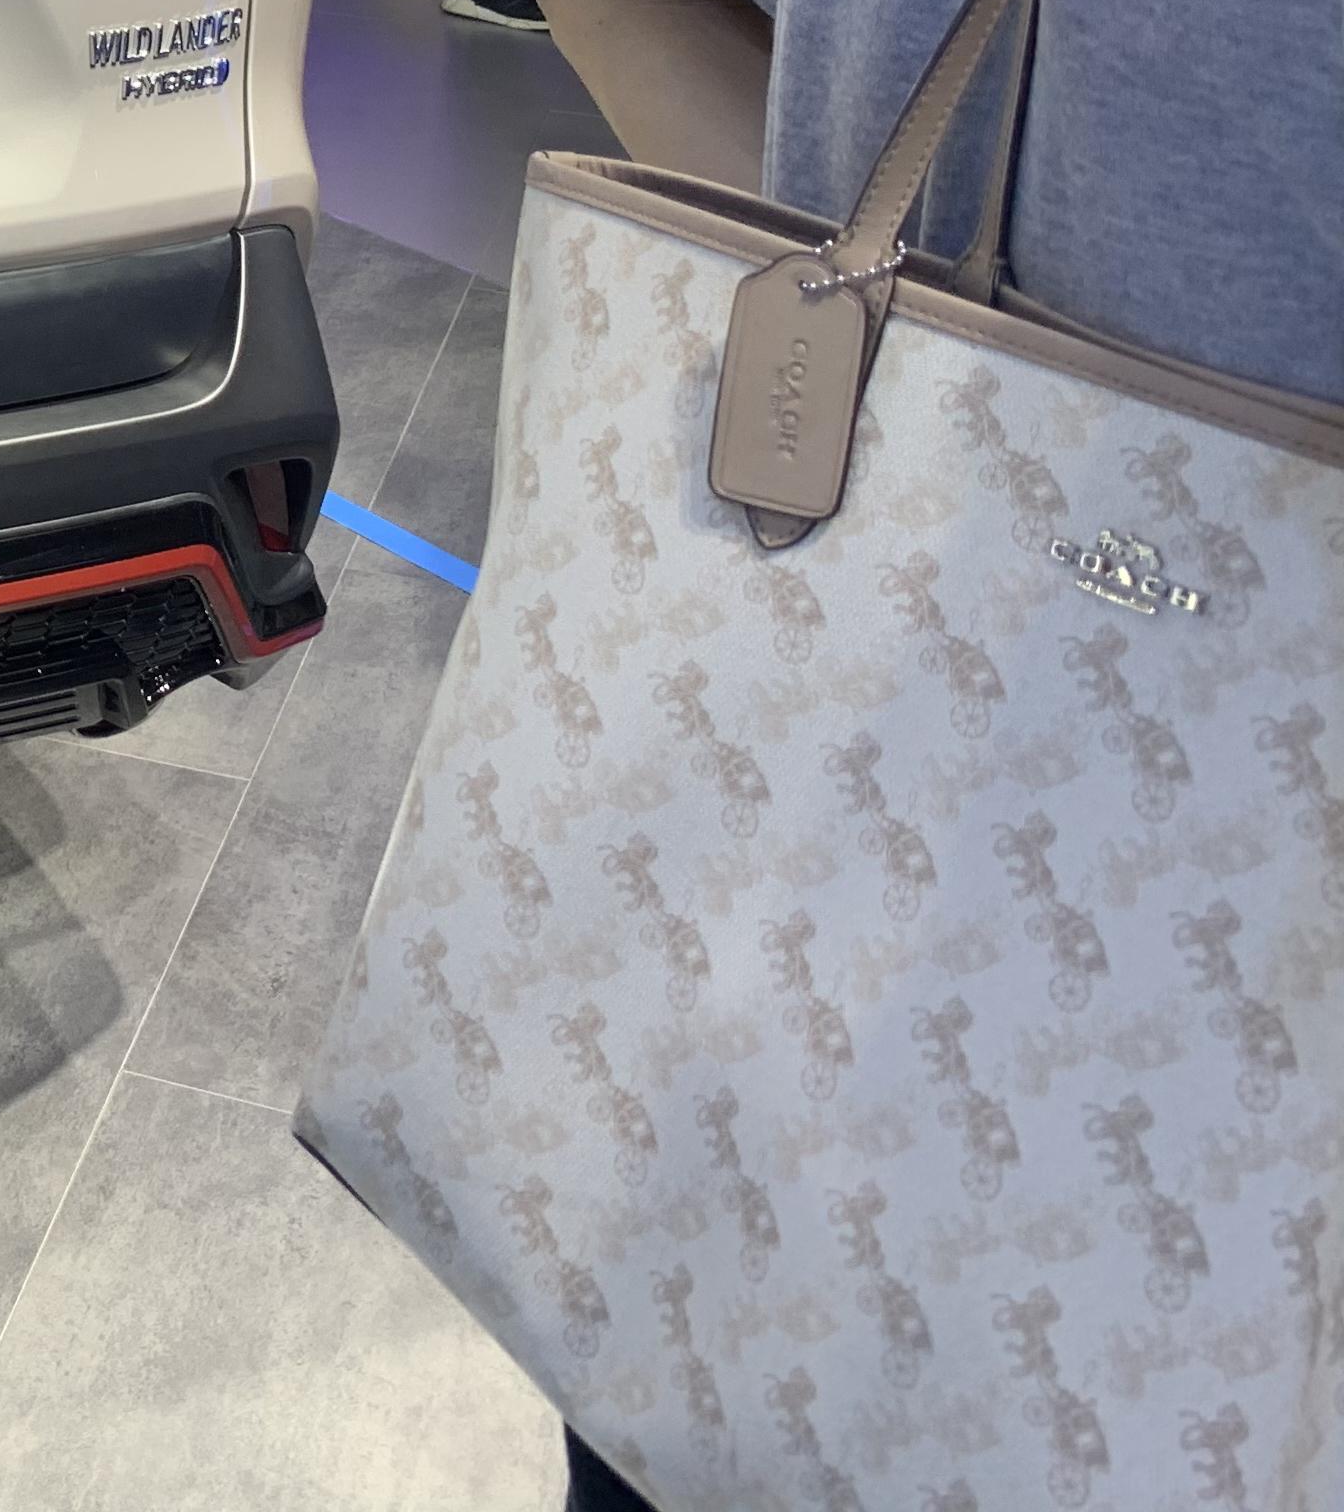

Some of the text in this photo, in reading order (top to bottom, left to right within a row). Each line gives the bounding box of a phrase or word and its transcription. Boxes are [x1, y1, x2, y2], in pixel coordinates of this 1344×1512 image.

[88, 8, 243, 69] WILDLANDER
[121, 57, 230, 101] HYBRID
[1050, 539, 1199, 612] COACH
